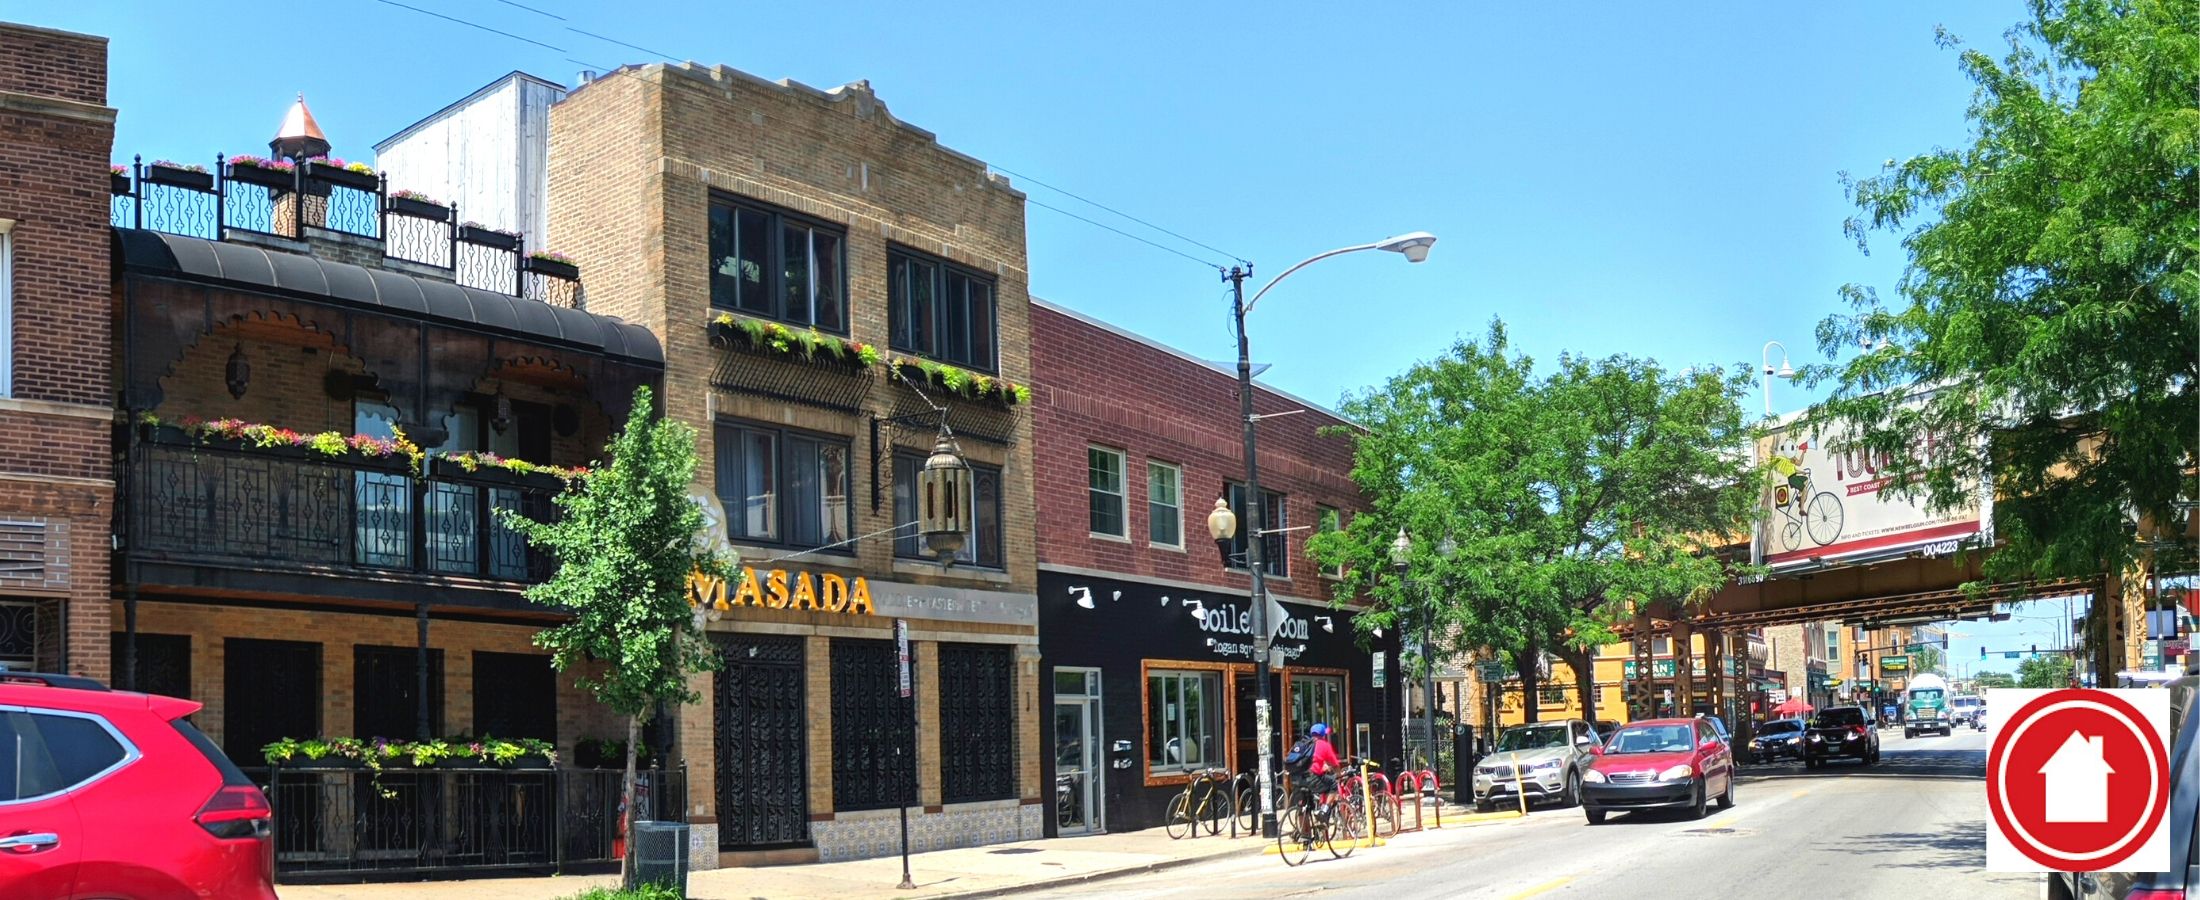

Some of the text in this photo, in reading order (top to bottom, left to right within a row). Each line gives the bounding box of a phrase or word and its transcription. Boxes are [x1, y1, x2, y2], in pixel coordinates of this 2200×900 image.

[1863, 481, 1880, 491] COAST
[1923, 540, 1958, 557] 004223
[683, 565, 876, 616] MASADA
[1199, 603, 1310, 640] boile oom
[1213, 639, 1238, 656] logan
